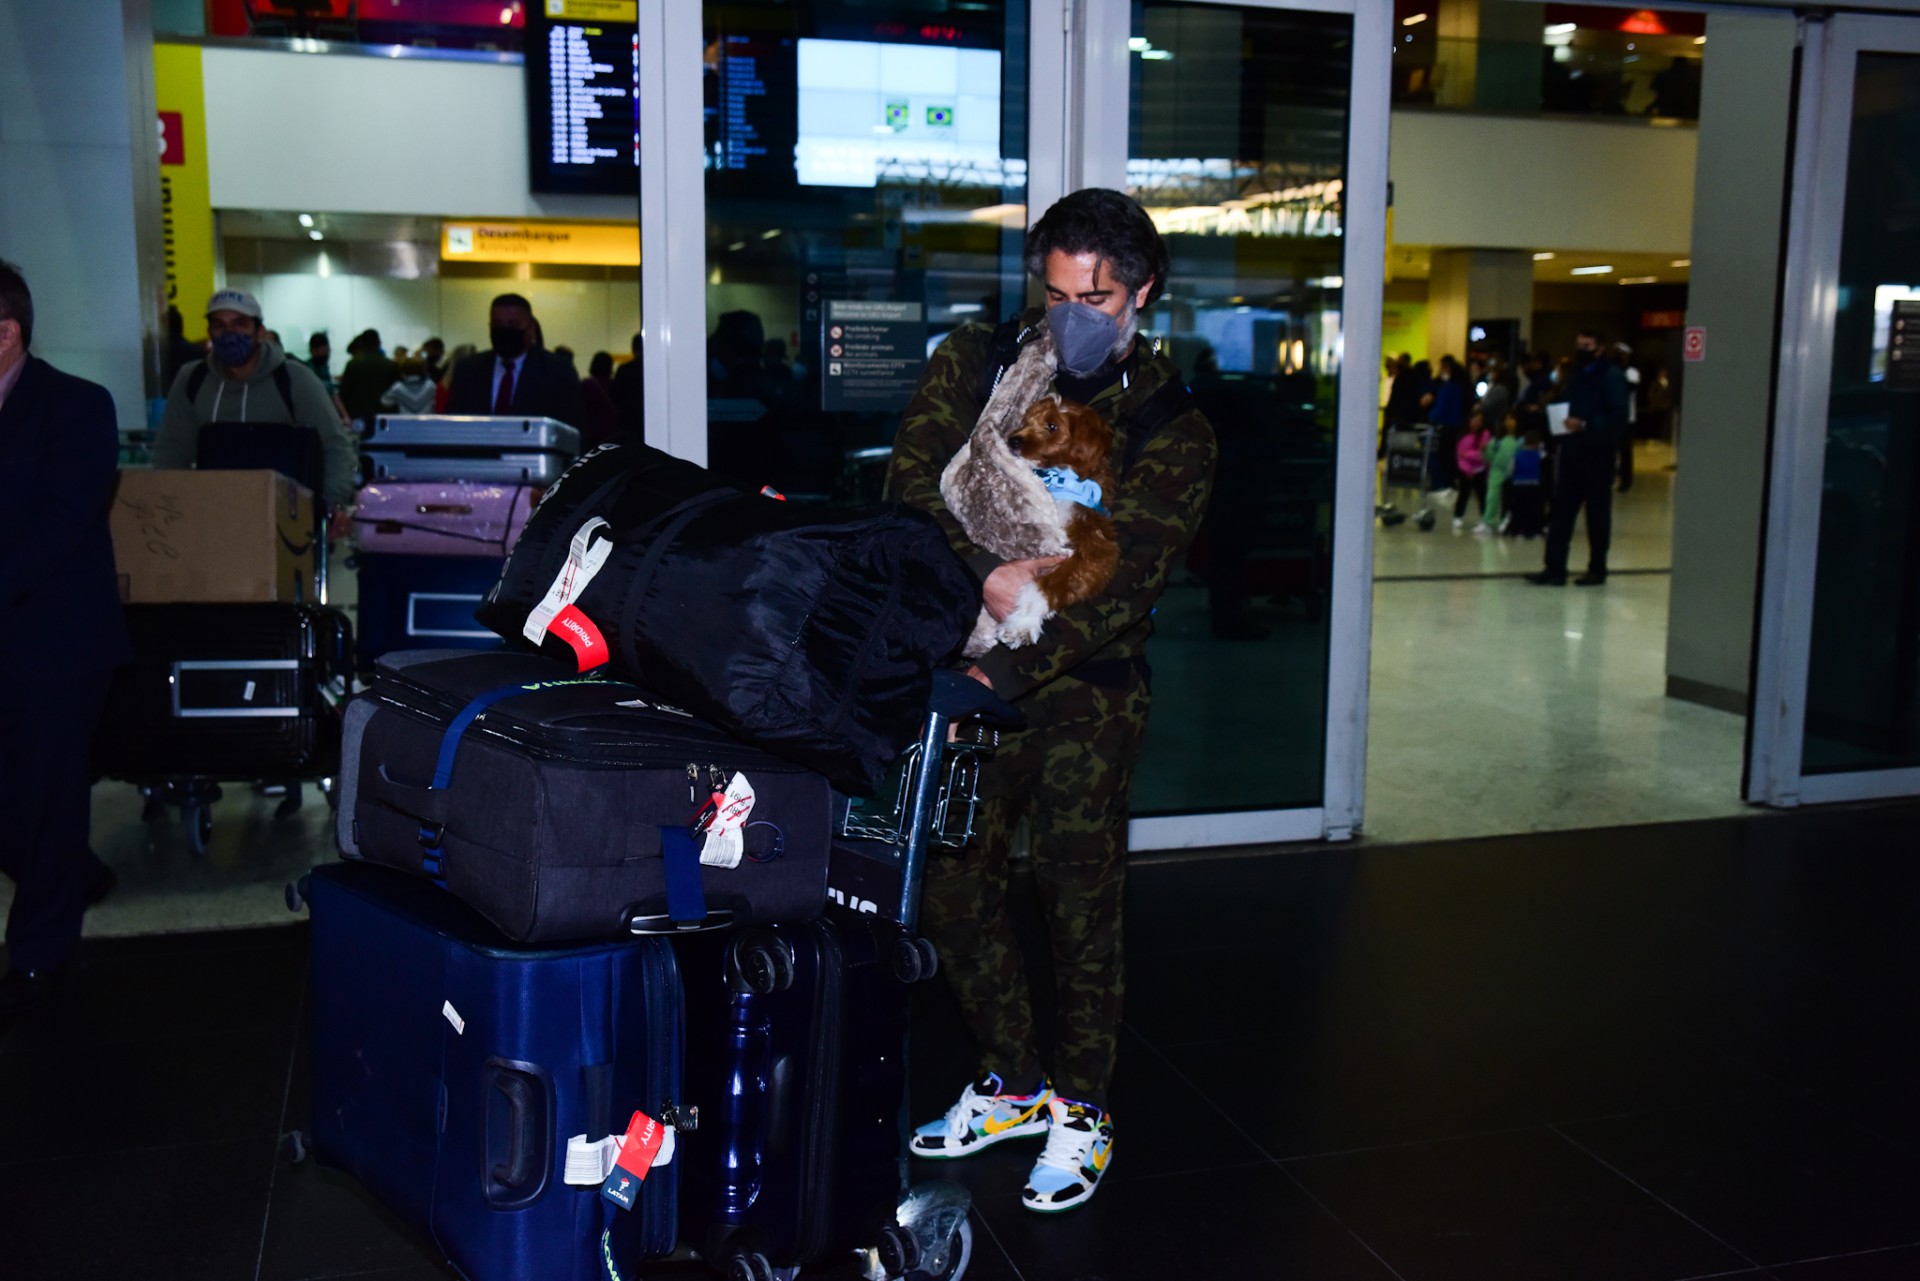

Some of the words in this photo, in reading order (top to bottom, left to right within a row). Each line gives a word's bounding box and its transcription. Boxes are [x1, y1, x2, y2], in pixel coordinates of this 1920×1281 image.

[477, 227, 571, 243] Desembarque
[561, 617, 594, 648] PRIORITY
[606, 1188, 630, 1204] LATAM
